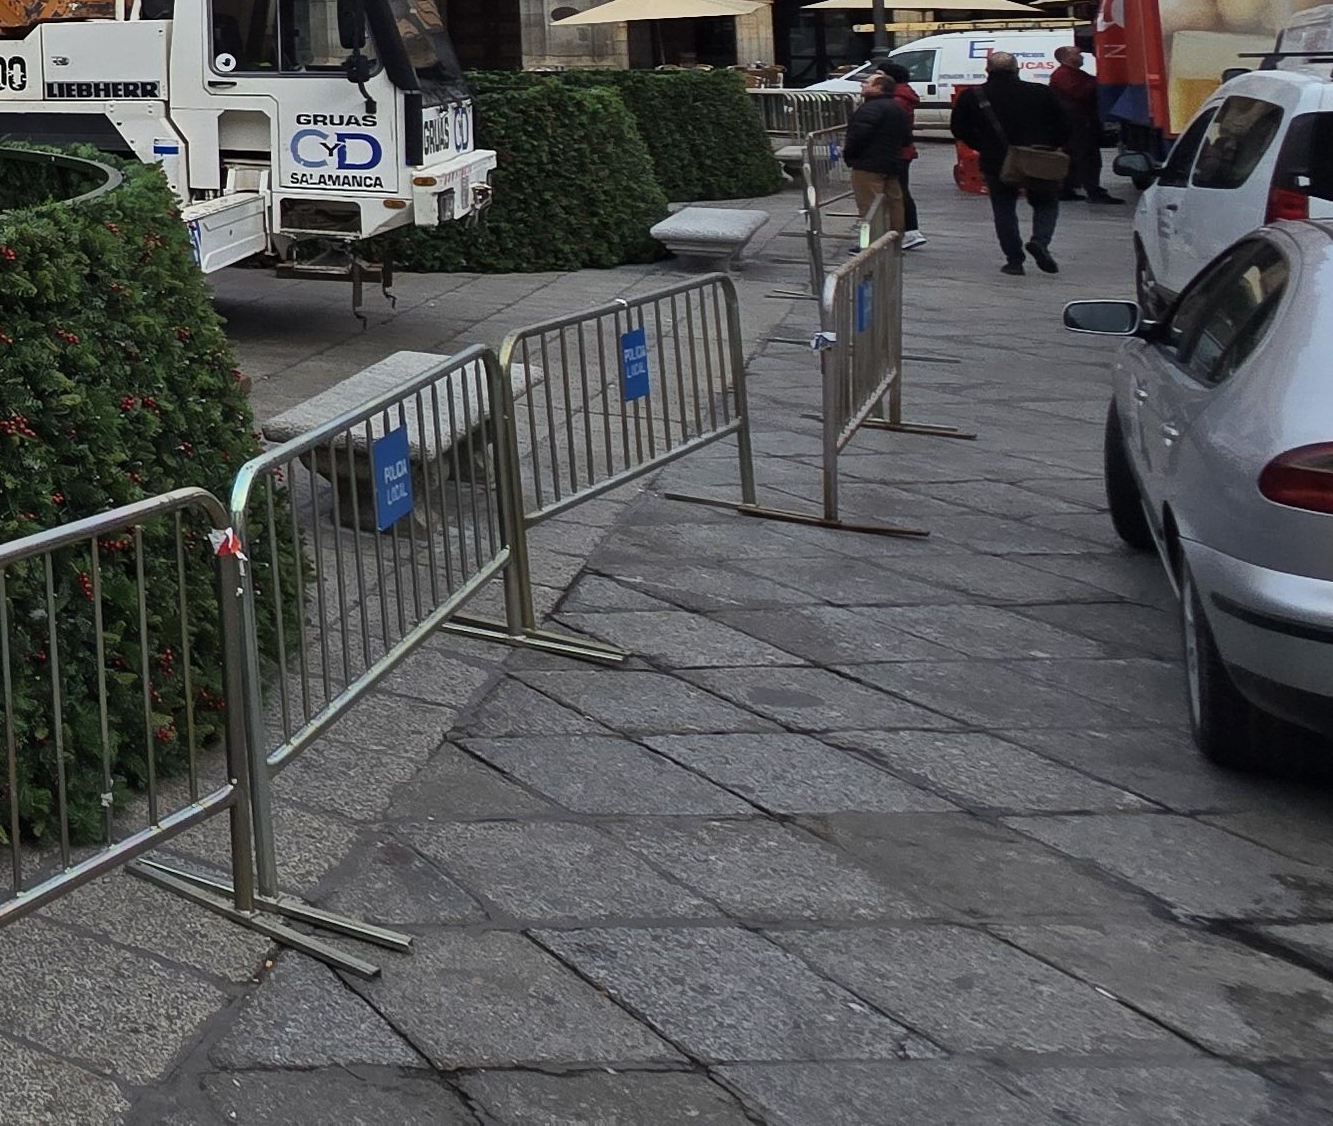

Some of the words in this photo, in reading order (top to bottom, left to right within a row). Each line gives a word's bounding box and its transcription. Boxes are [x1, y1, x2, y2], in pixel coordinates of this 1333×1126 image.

[47, 82, 159, 99] LIEBHERR
[296, 114, 377, 127] GRUAS
[424, 117, 450, 155] GRUAS
[290, 173, 384, 188] SALAMANCA
